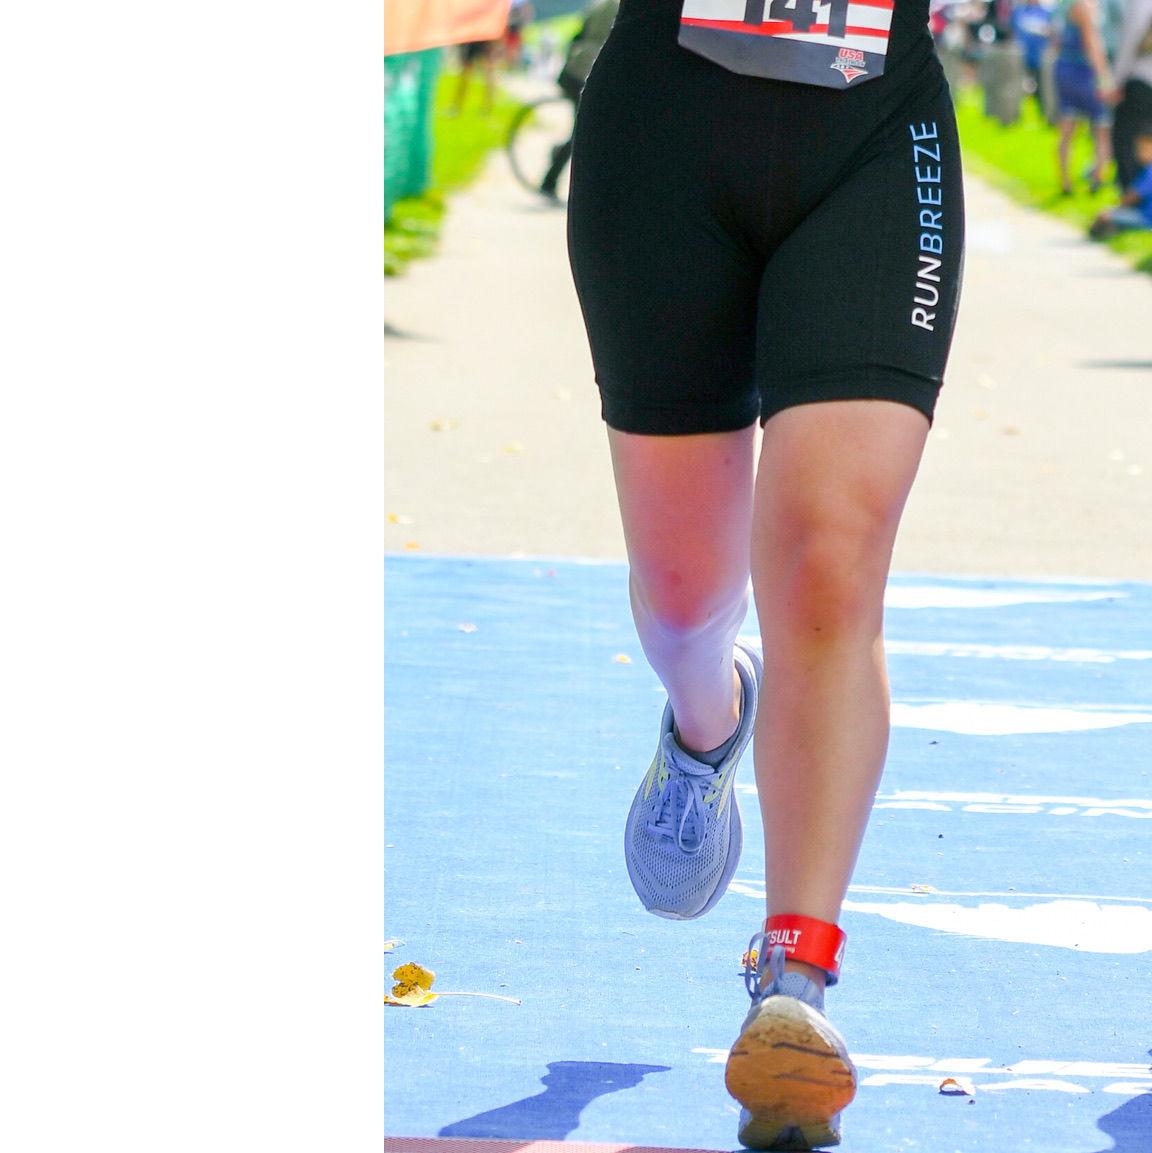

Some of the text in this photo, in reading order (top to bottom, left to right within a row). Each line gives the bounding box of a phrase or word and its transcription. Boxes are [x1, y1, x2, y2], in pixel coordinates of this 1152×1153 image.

[838, 47, 864, 61] USA
[909, 121, 944, 332] RUNBREEZE
[767, 929, 802, 944] SULT
